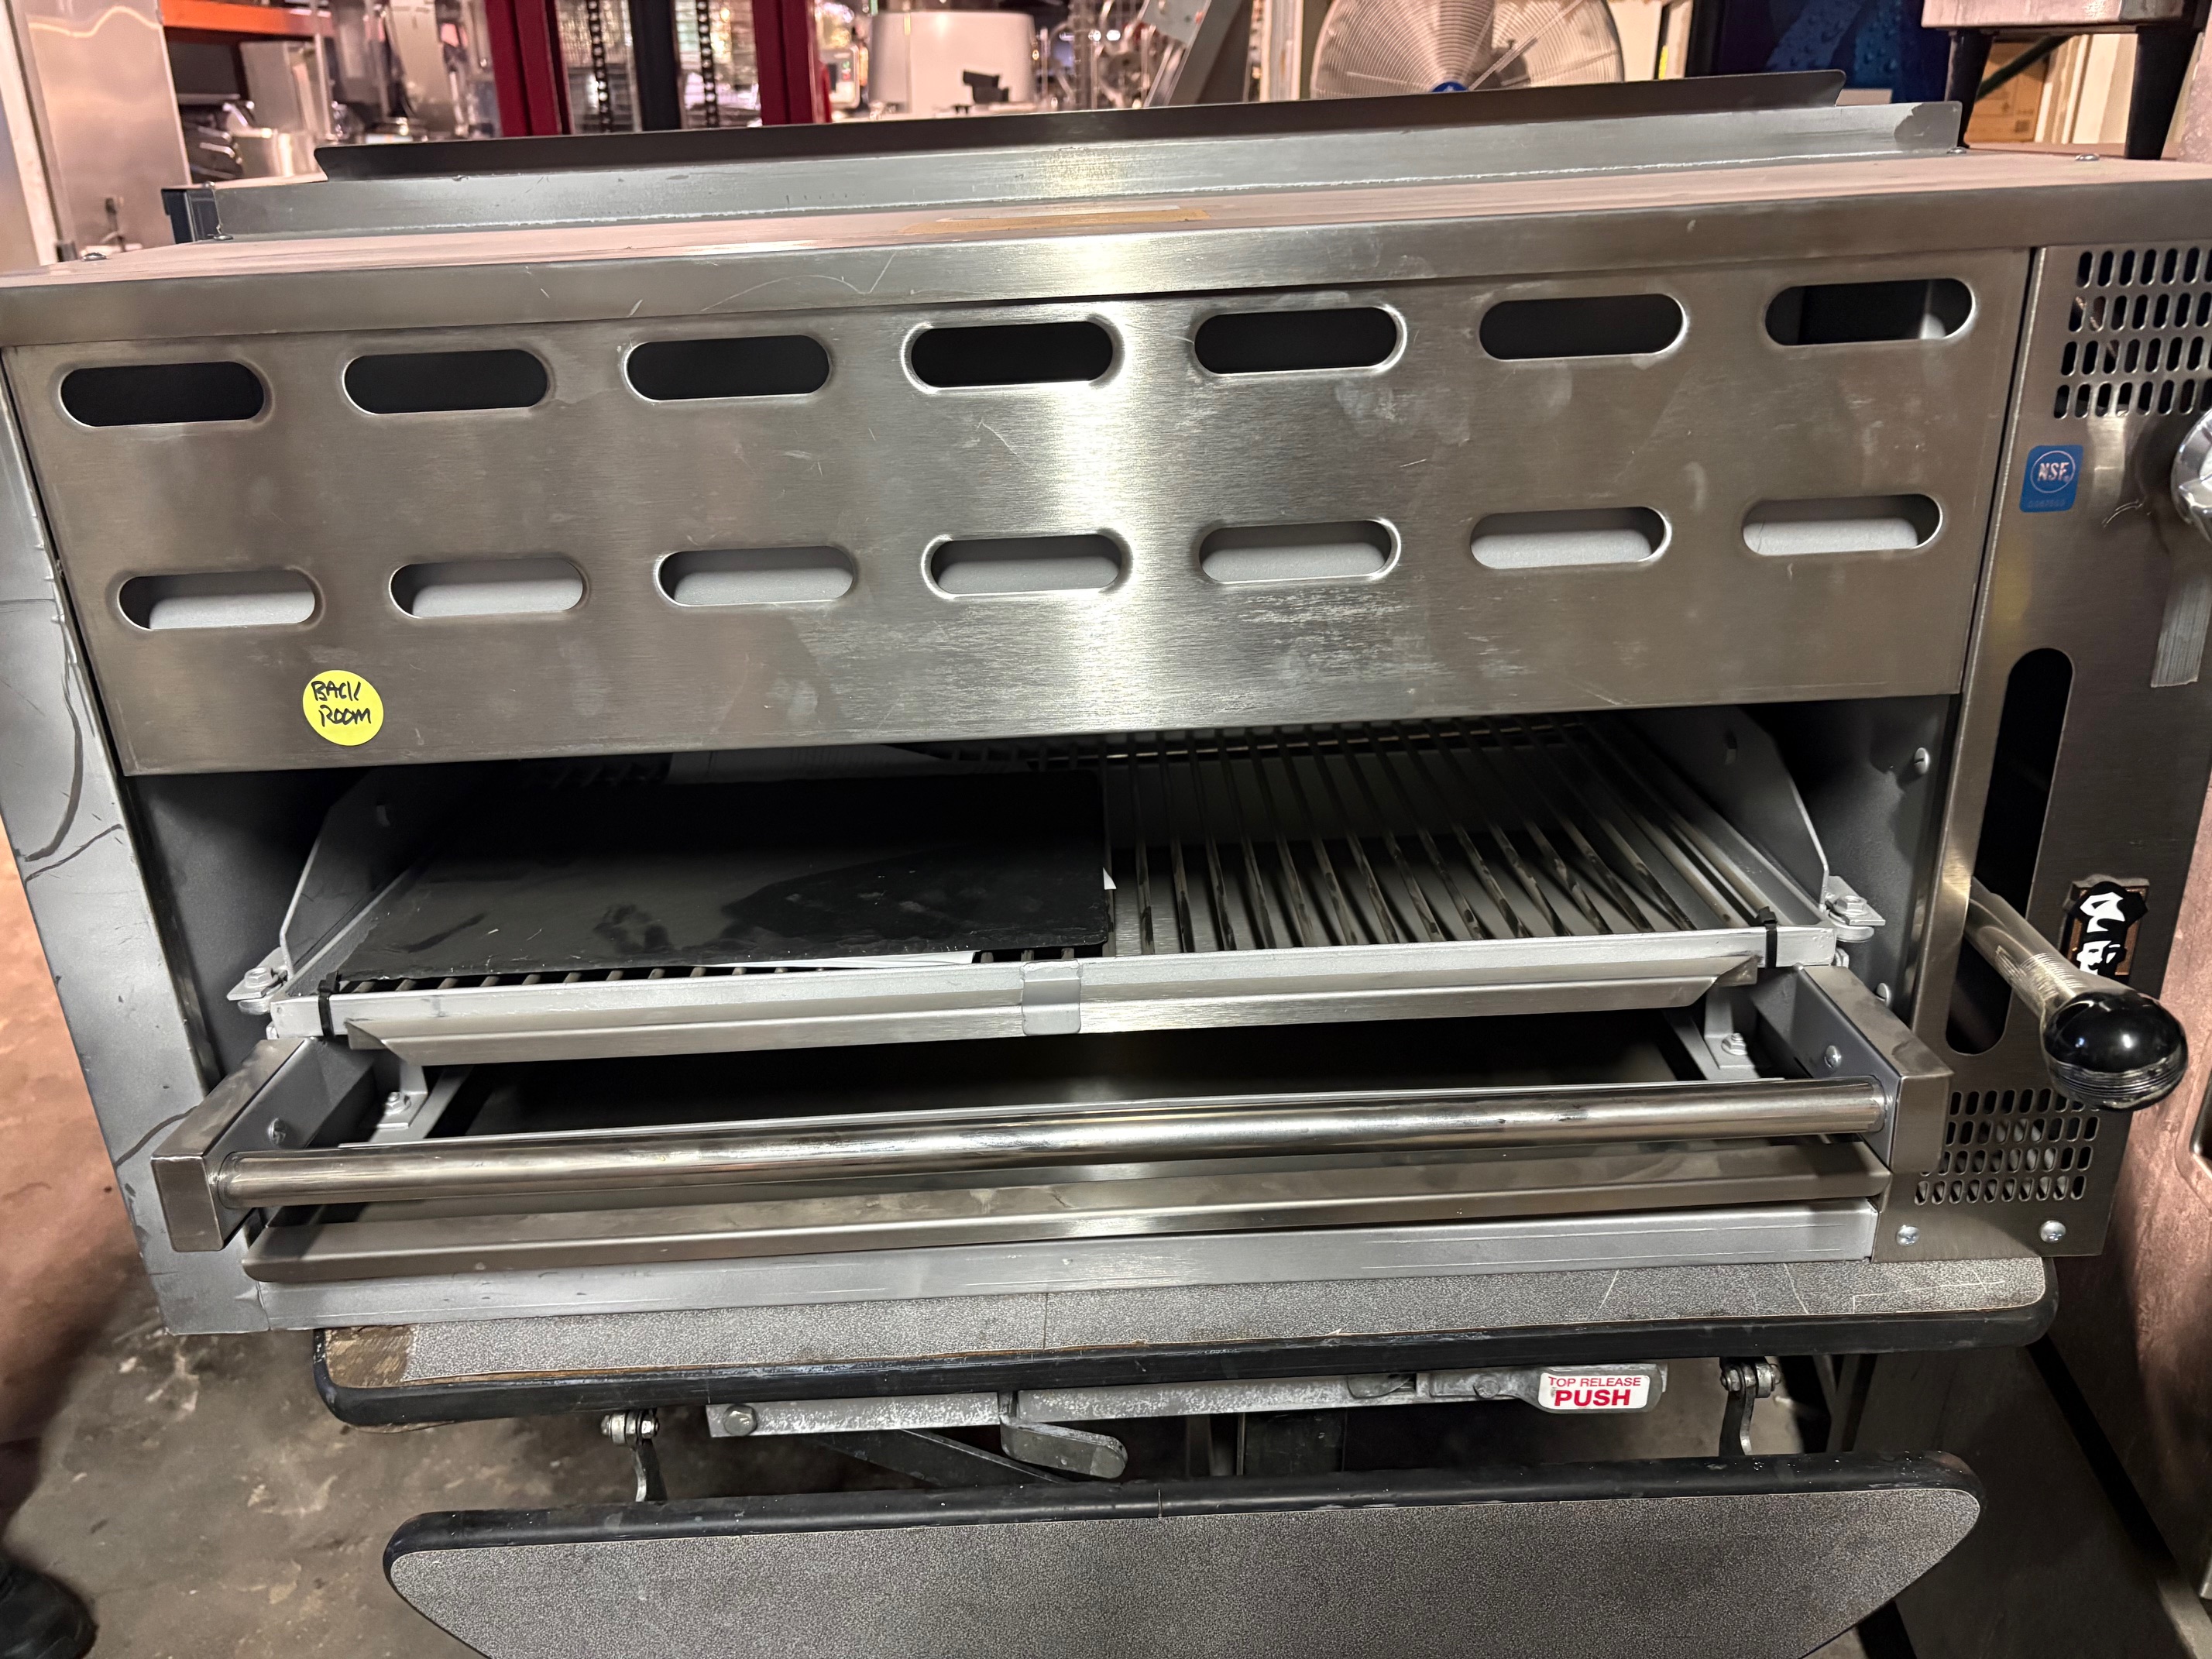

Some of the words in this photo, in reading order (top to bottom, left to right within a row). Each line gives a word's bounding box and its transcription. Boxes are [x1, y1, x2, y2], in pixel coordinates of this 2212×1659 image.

[2037, 462, 2069, 482] NSF
[311, 680, 362, 702] BACK
[318, 704, 372, 727] ROOM
[1548, 1376, 1576, 1387] TOP
[1580, 1377, 1641, 1387] RELEASE
[1554, 1389, 1631, 1407] PUSH
